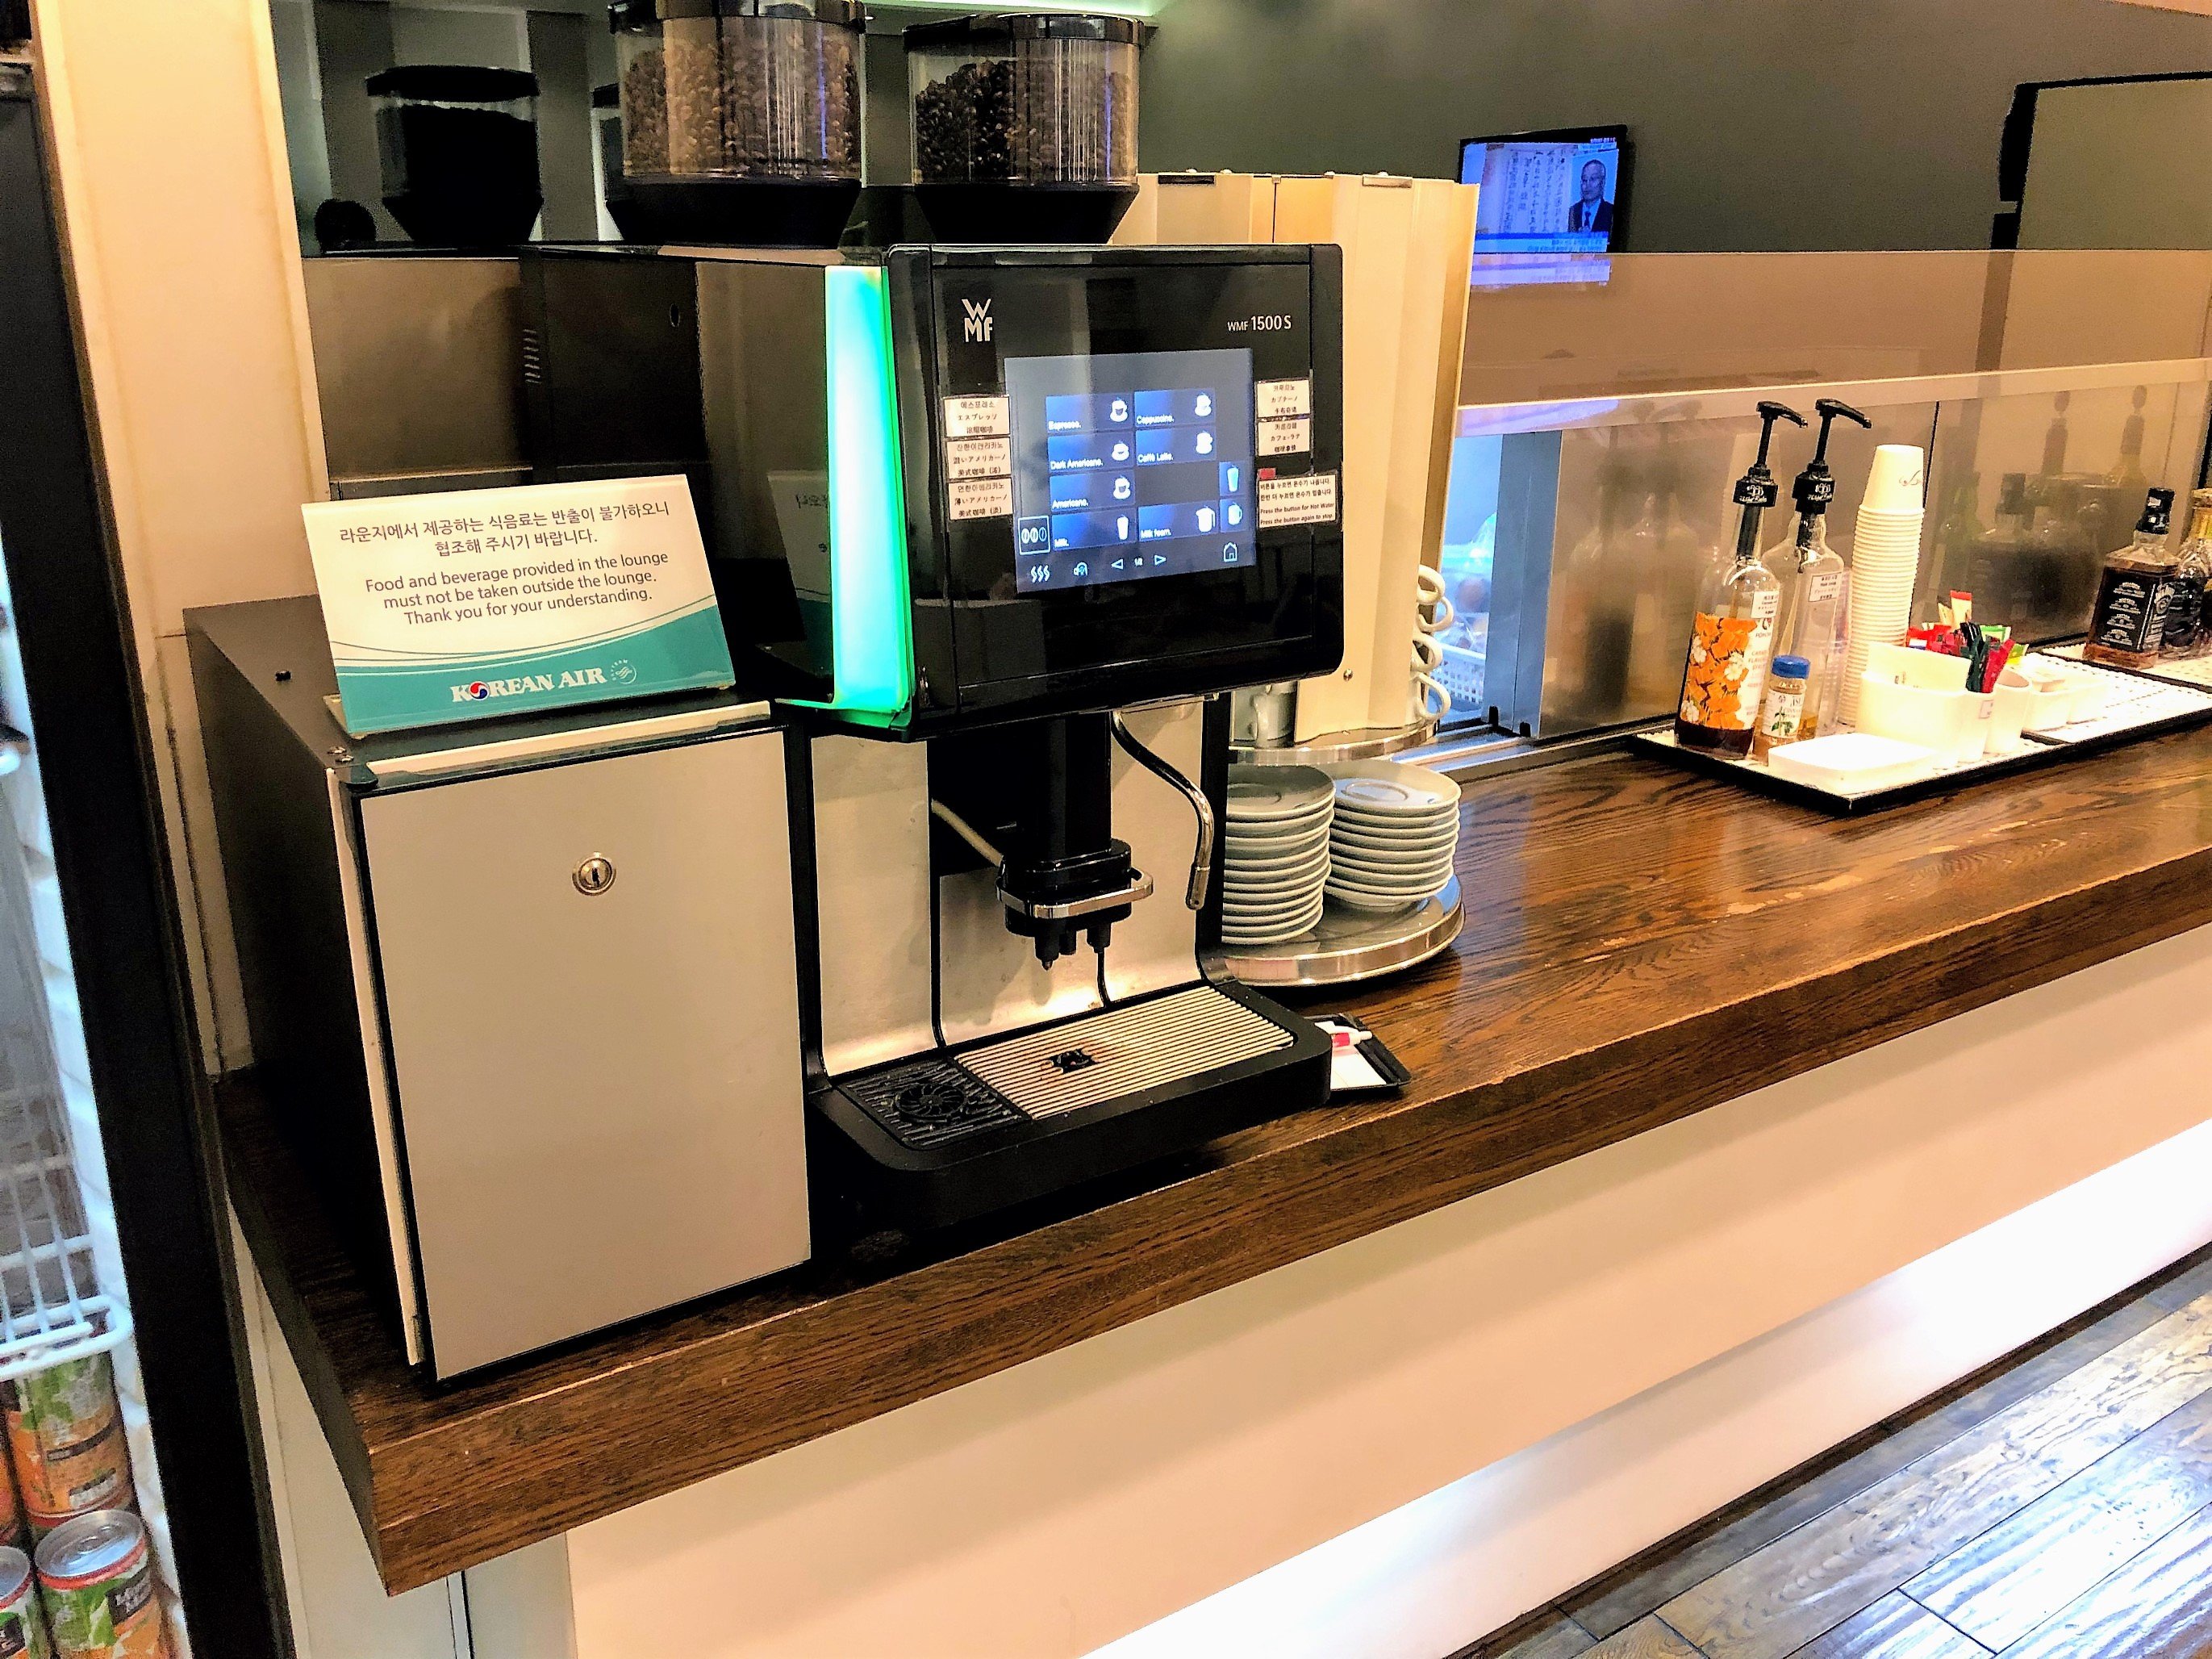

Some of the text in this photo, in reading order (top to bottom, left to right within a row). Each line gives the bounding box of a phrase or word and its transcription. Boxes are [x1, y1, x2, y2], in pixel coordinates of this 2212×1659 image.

[1227, 321, 1249, 332] WMF
[1251, 315, 1282, 331] 1500
[340, 501, 670, 543] 라운지에서 제공하는 식음료는 반출이 불가하오니
[435, 529, 598, 557] 협조해 주시기 바랍니다.
[365, 553, 669, 592] Food and beverage provided in the lounge
[384, 572, 657, 609] must not be taken outside the lounge.
[404, 588, 653, 625] Thank you for your understanding.
[450, 674, 555, 702] KOREAN
[558, 667, 607, 688] AIR
